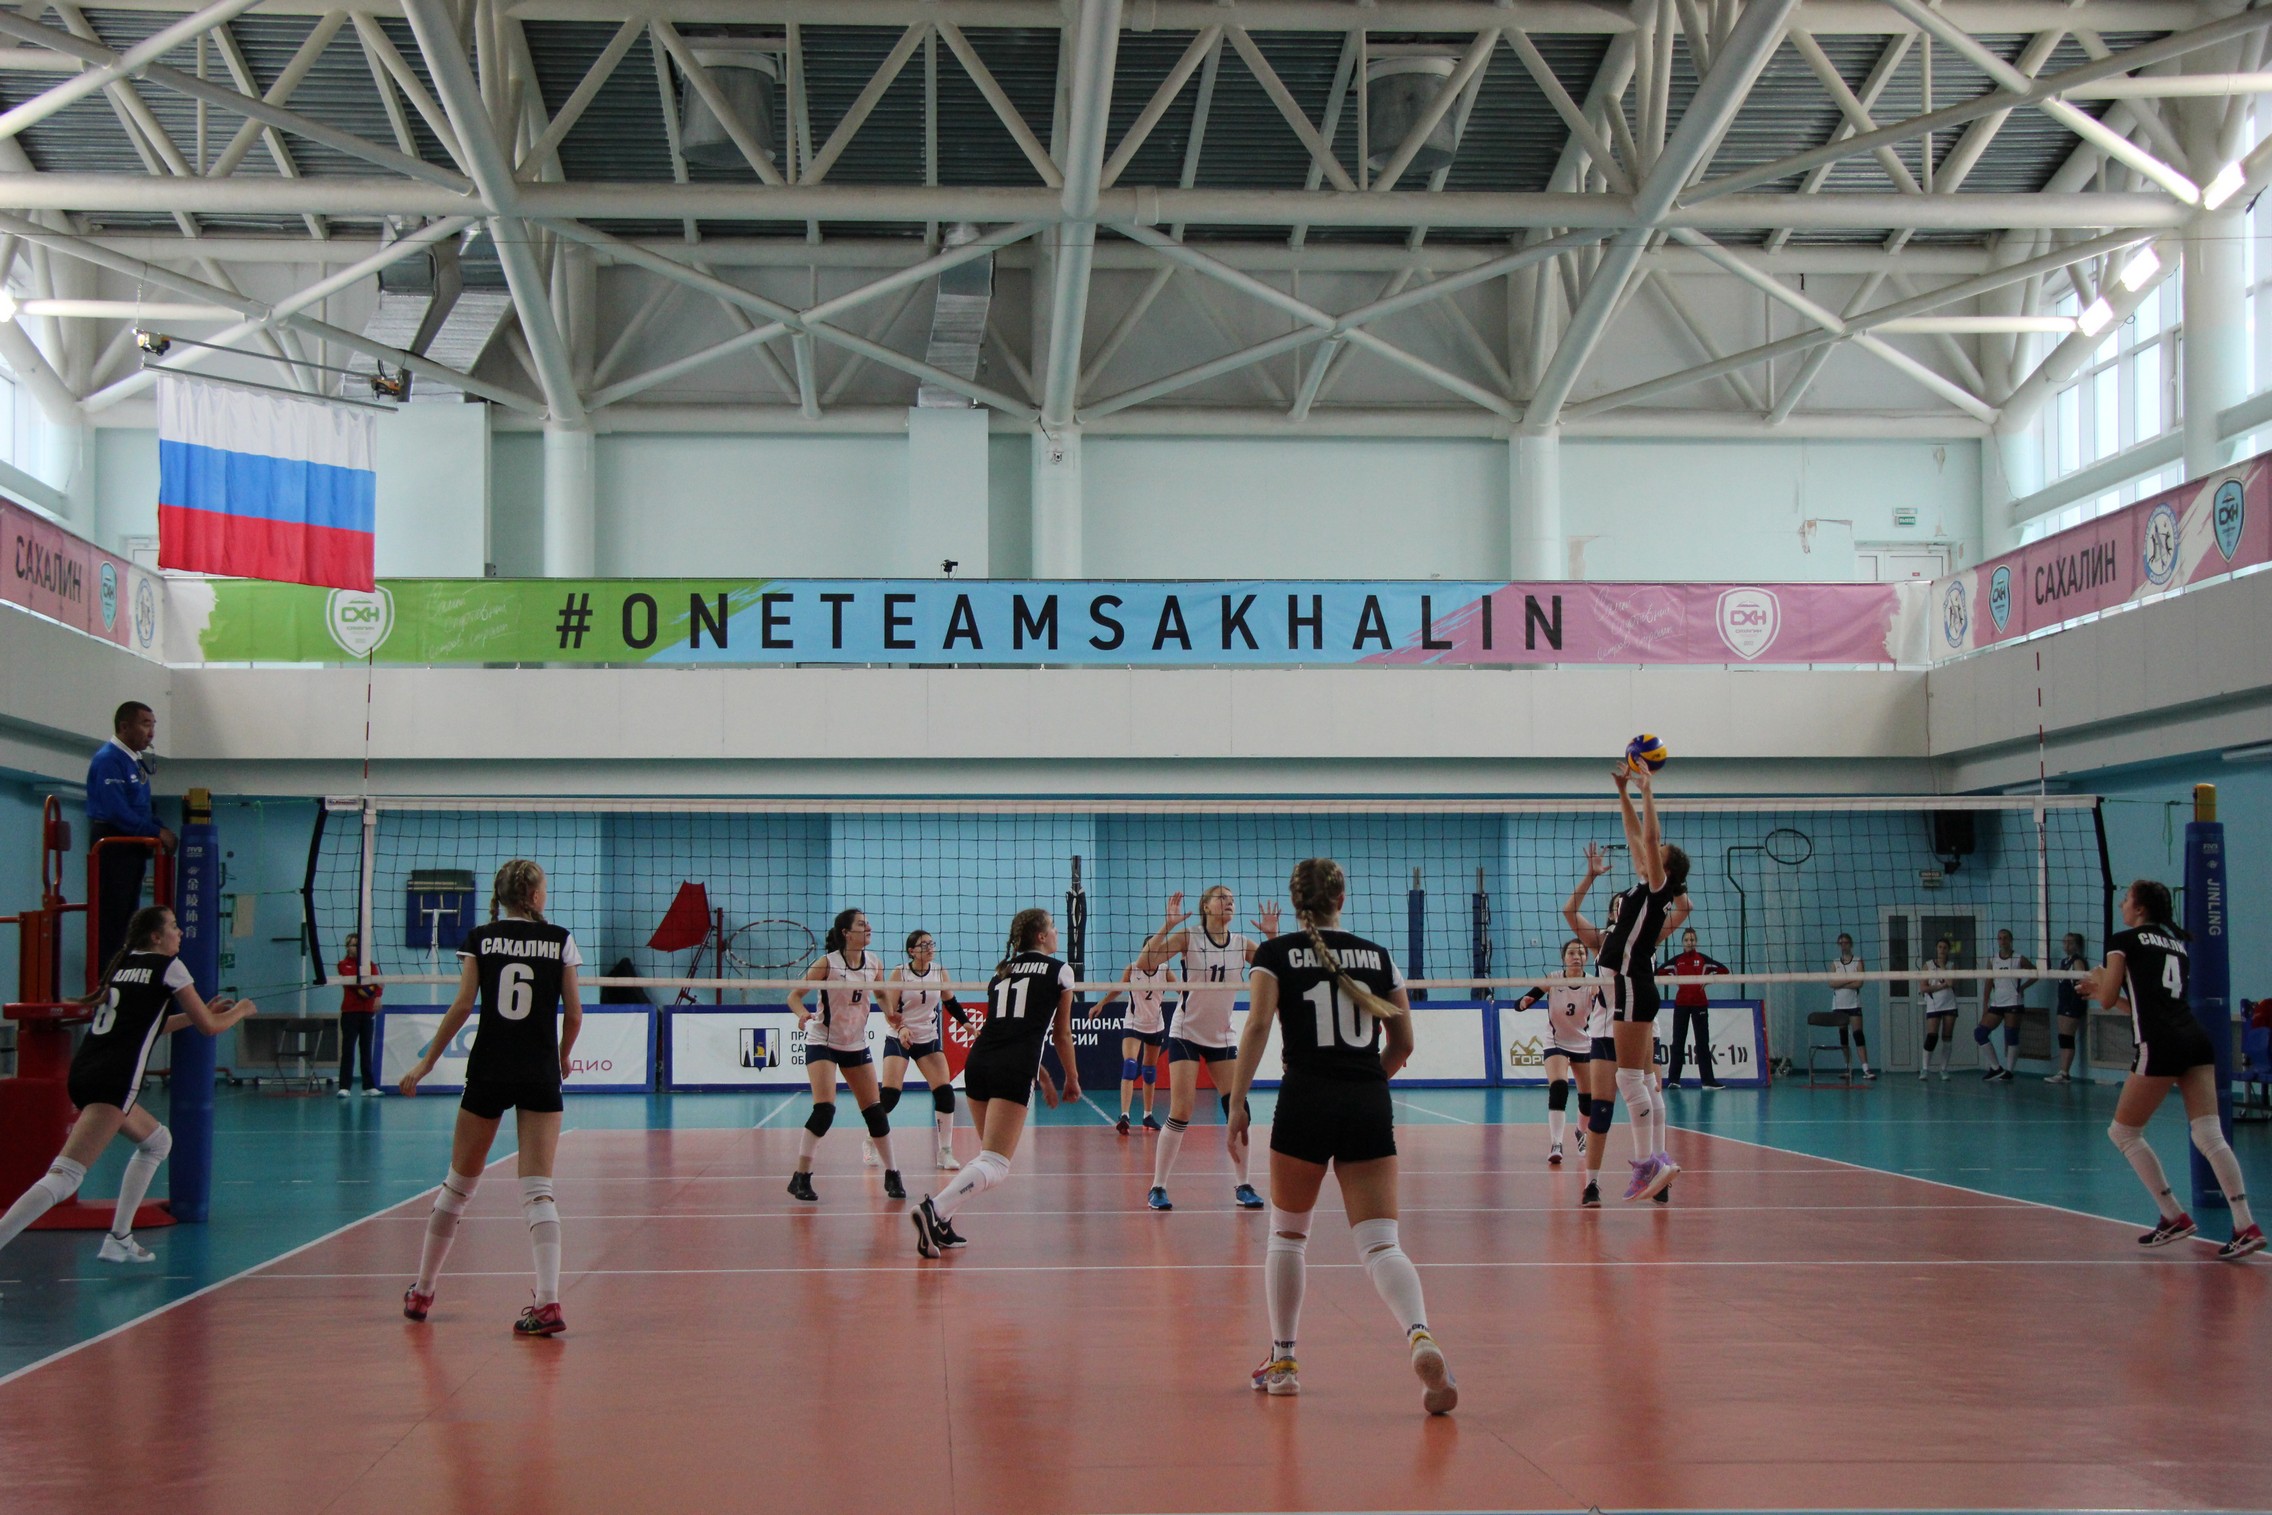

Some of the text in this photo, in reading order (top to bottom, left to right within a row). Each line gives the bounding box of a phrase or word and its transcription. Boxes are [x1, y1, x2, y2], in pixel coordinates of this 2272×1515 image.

[16, 535, 82, 603] САХАЛИН
[2035, 540, 2116, 605] САХАЛИН
[556, 592, 1562, 651] #ONETEAMSAKHALIN
[2207, 878, 2222, 936] JINLING
[481, 937, 560, 960] САХАЛИН
[1010, 962, 1049, 975] АЛИН
[1288, 948, 1382, 971] САЛИН
[111, 968, 153, 984] АЛИН
[497, 962, 535, 1020] 6
[994, 977, 1031, 1018] 11
[2161, 953, 2183, 999] 4
[91, 987, 120, 1035] 8
[1302, 980, 1374, 1048] 10
[1565, 1003, 1576, 1016] 3
[571, 1059, 613, 1073] ДИО
